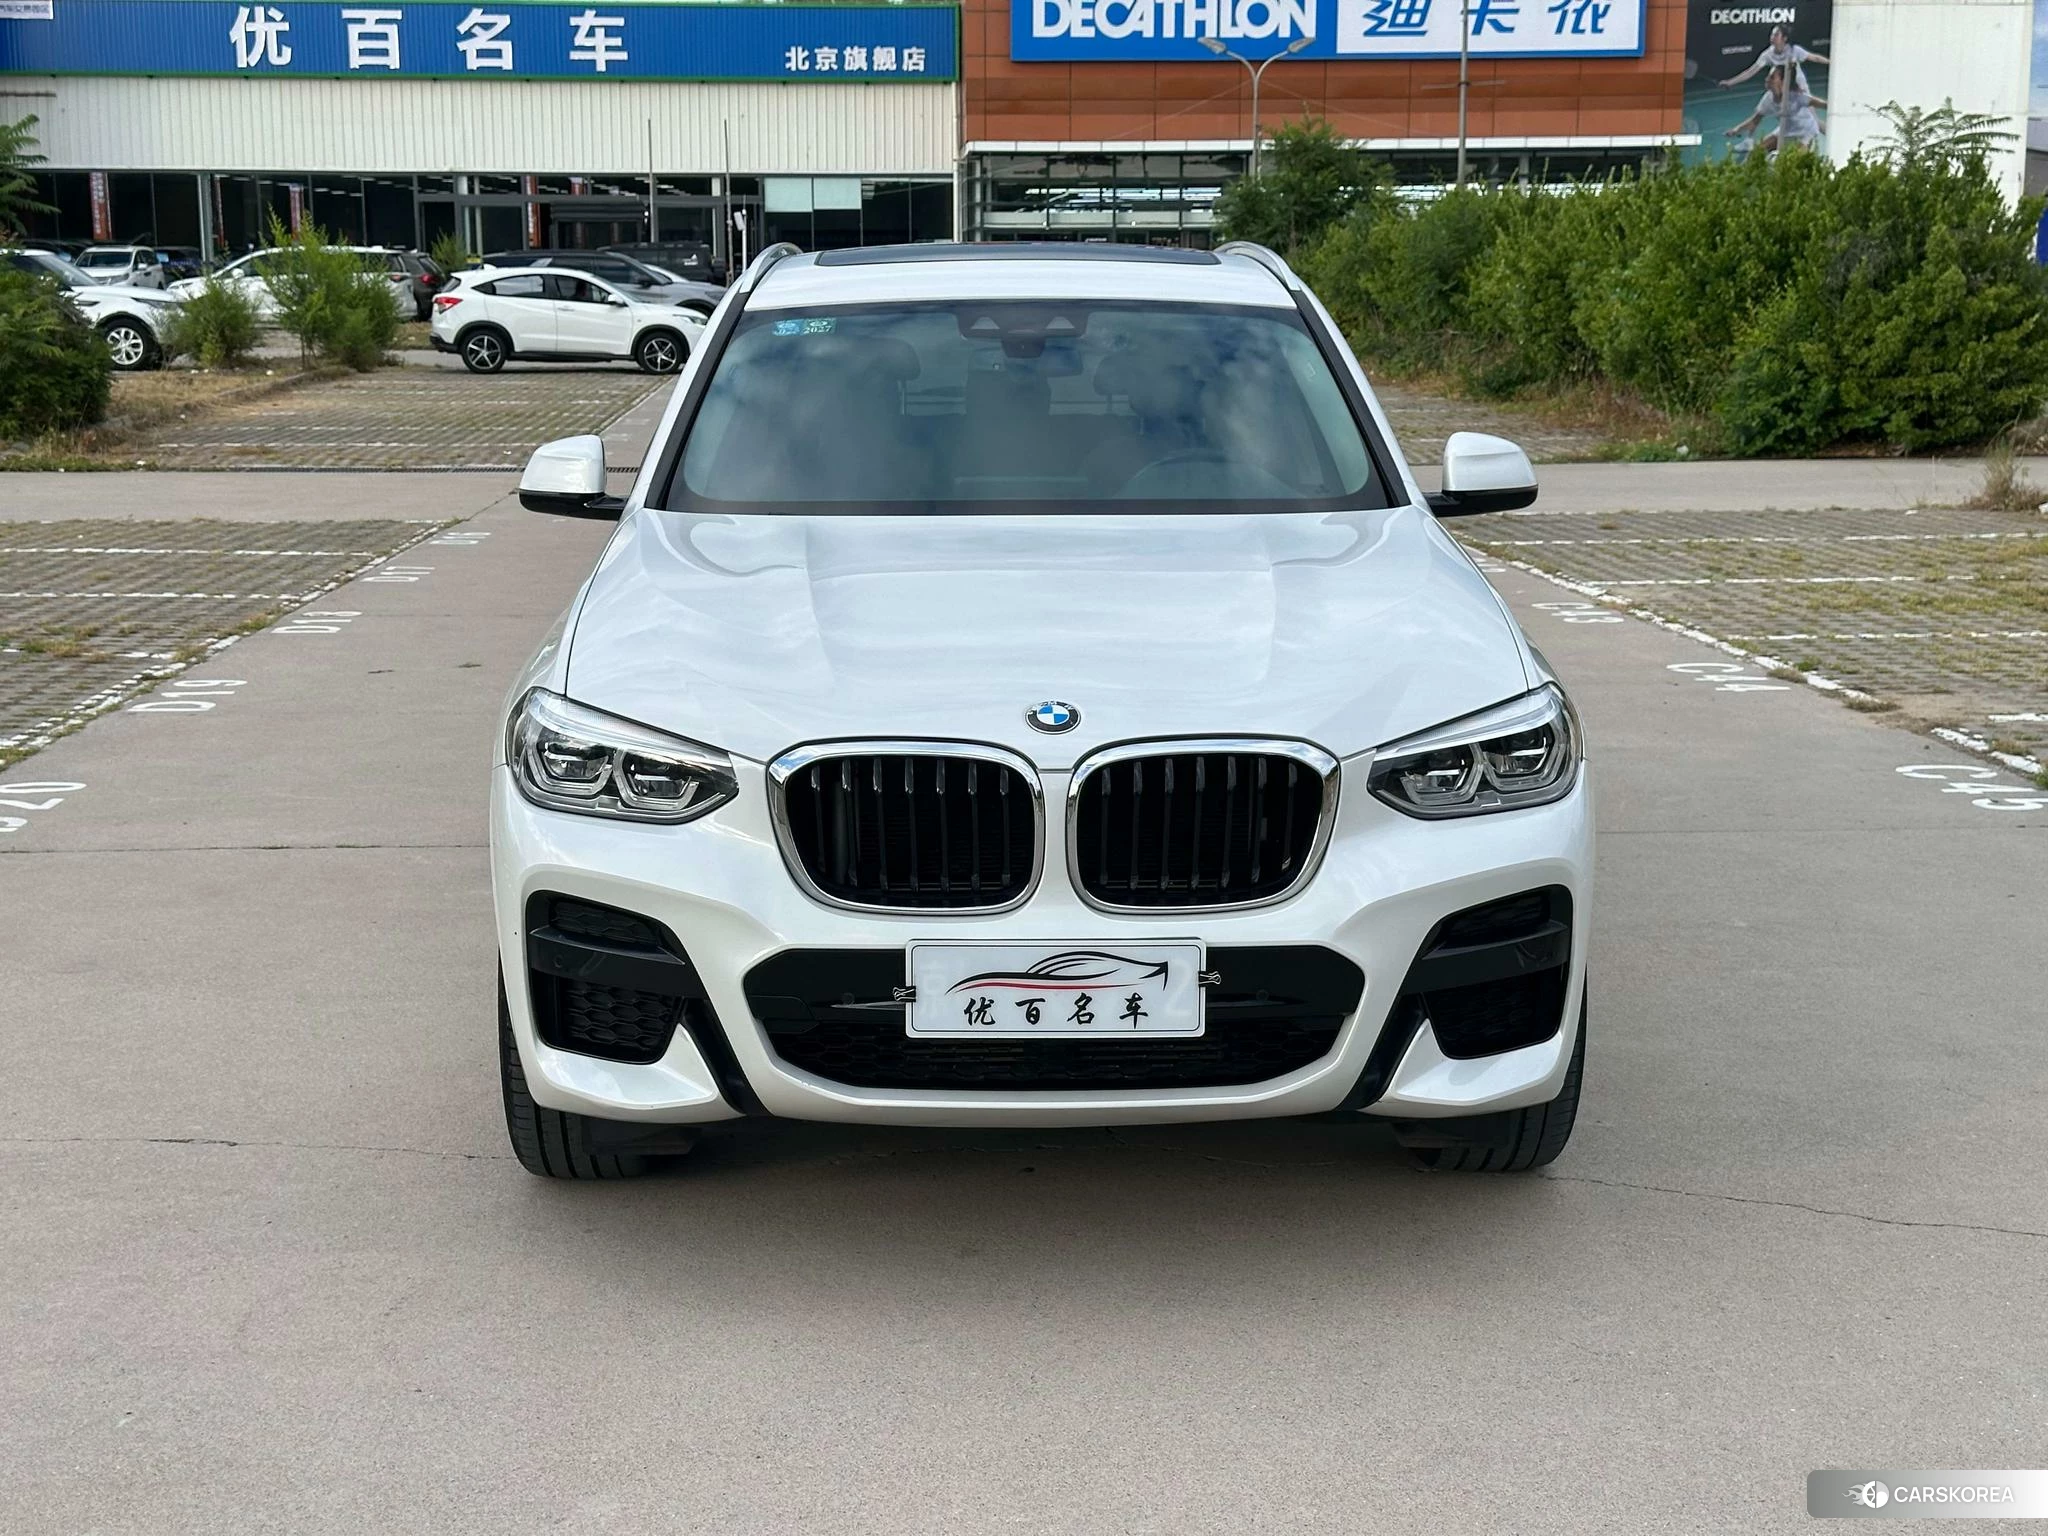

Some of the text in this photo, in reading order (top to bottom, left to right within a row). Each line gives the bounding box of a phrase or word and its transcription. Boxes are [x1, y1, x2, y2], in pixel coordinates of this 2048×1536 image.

[1032, 0, 1316, 38] DECATHLON
[1710, 8, 1796, 24] DECATHLON
[229, 7, 628, 72] 优百名车
[785, 46, 926, 72] 北京旗舰店
[360, 566, 435, 582] D17
[127, 680, 248, 712] D19
[963, 992, 1149, 1029] 优百名车
